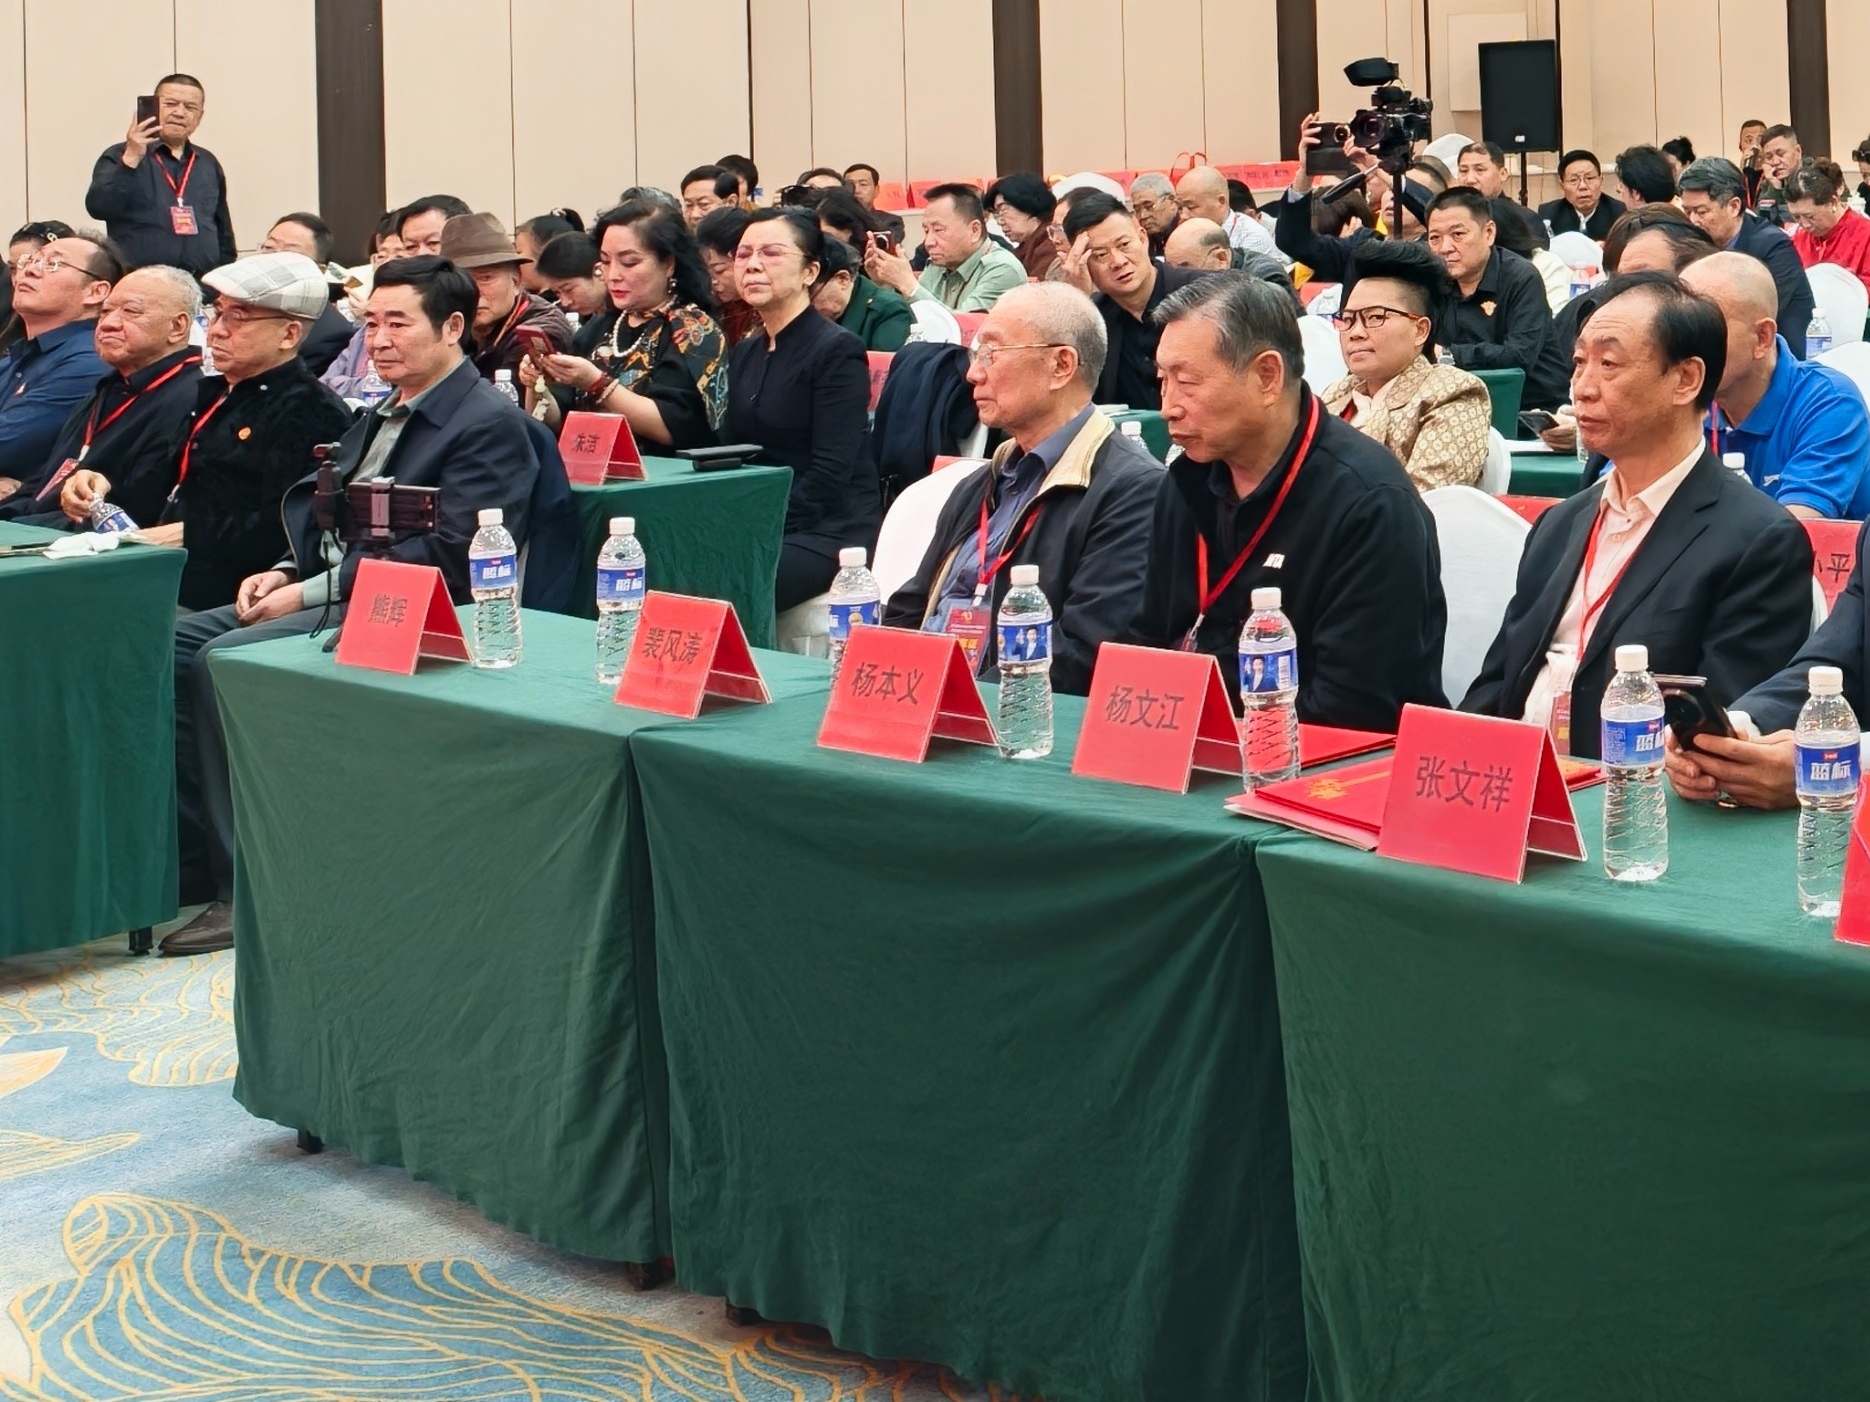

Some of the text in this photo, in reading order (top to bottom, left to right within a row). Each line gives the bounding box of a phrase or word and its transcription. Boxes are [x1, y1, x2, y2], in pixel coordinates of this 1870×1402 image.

[642, 626, 703, 665] 裴风涛
[851, 661, 925, 705] 杨本义
[1104, 685, 1185, 731] 杨文江
[1415, 754, 1514, 813] 张文祥
